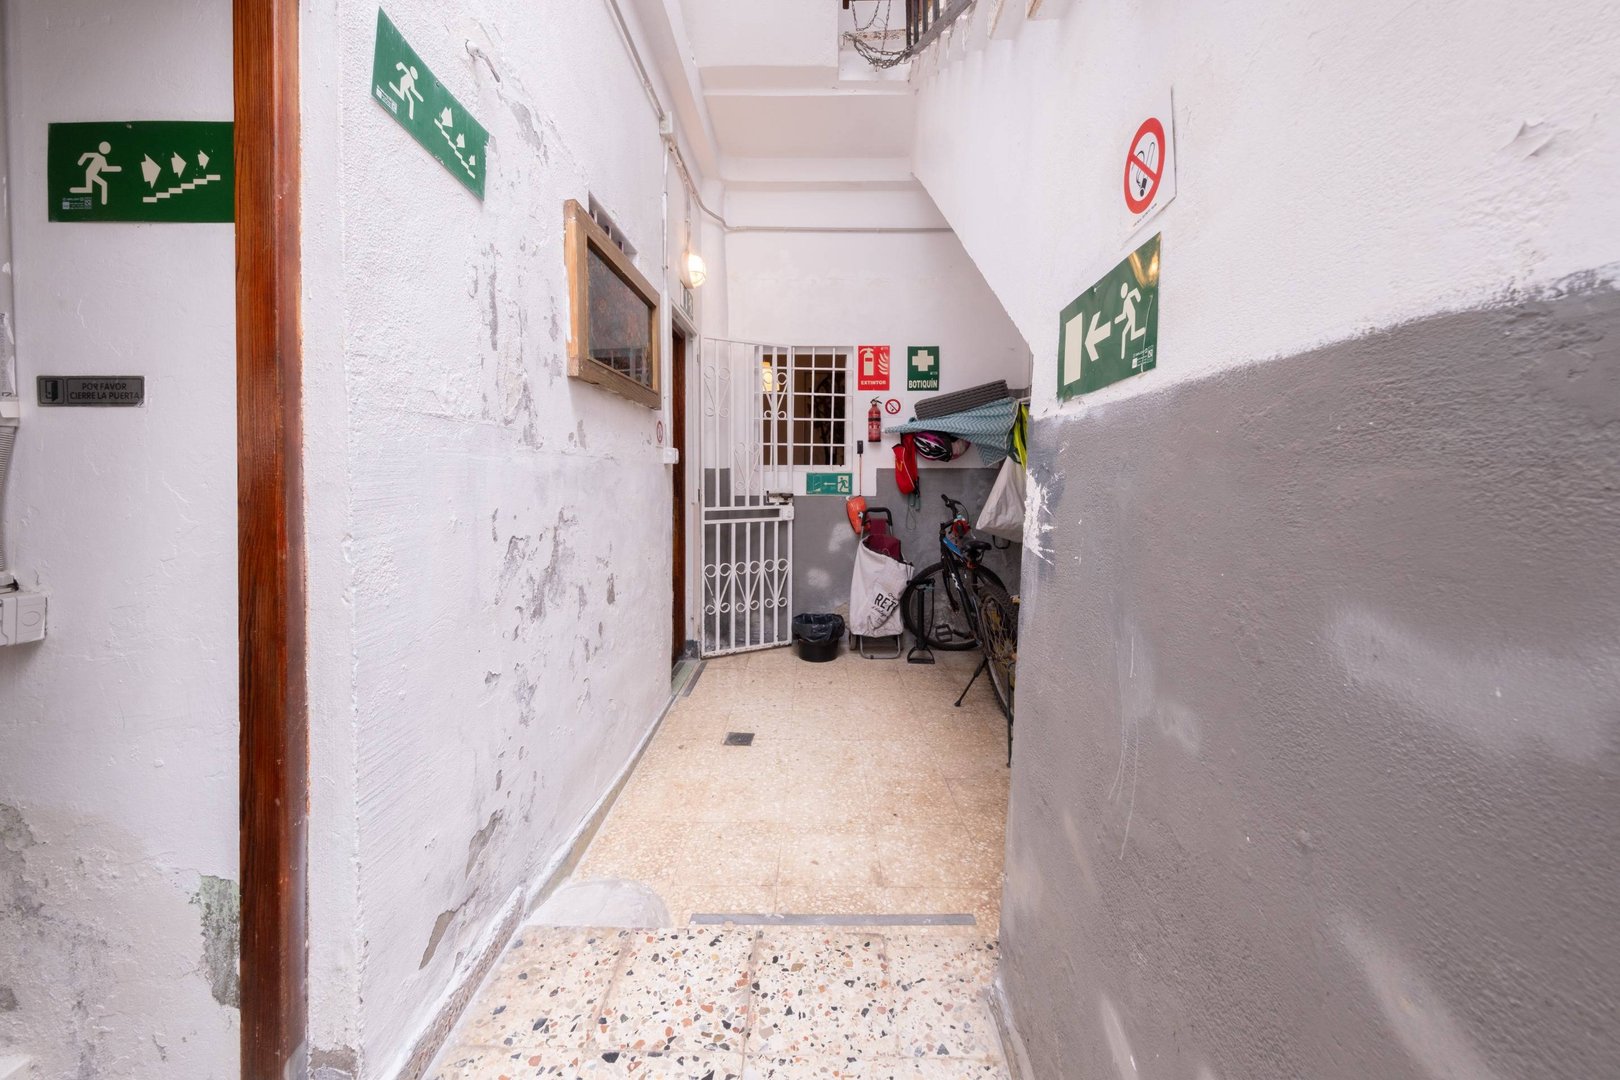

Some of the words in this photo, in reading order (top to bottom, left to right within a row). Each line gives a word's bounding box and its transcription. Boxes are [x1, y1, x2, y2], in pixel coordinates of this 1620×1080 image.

[82, 382, 98, 391] POR
[99, 382, 127, 391] FAVOR
[908, 378, 938, 389] BOTIQUÍN
[69, 391, 97, 400] CIERRE
[97, 391, 107, 400] LA
[108, 391, 140, 400] PUERTA
[874, 593, 898, 611] RET
